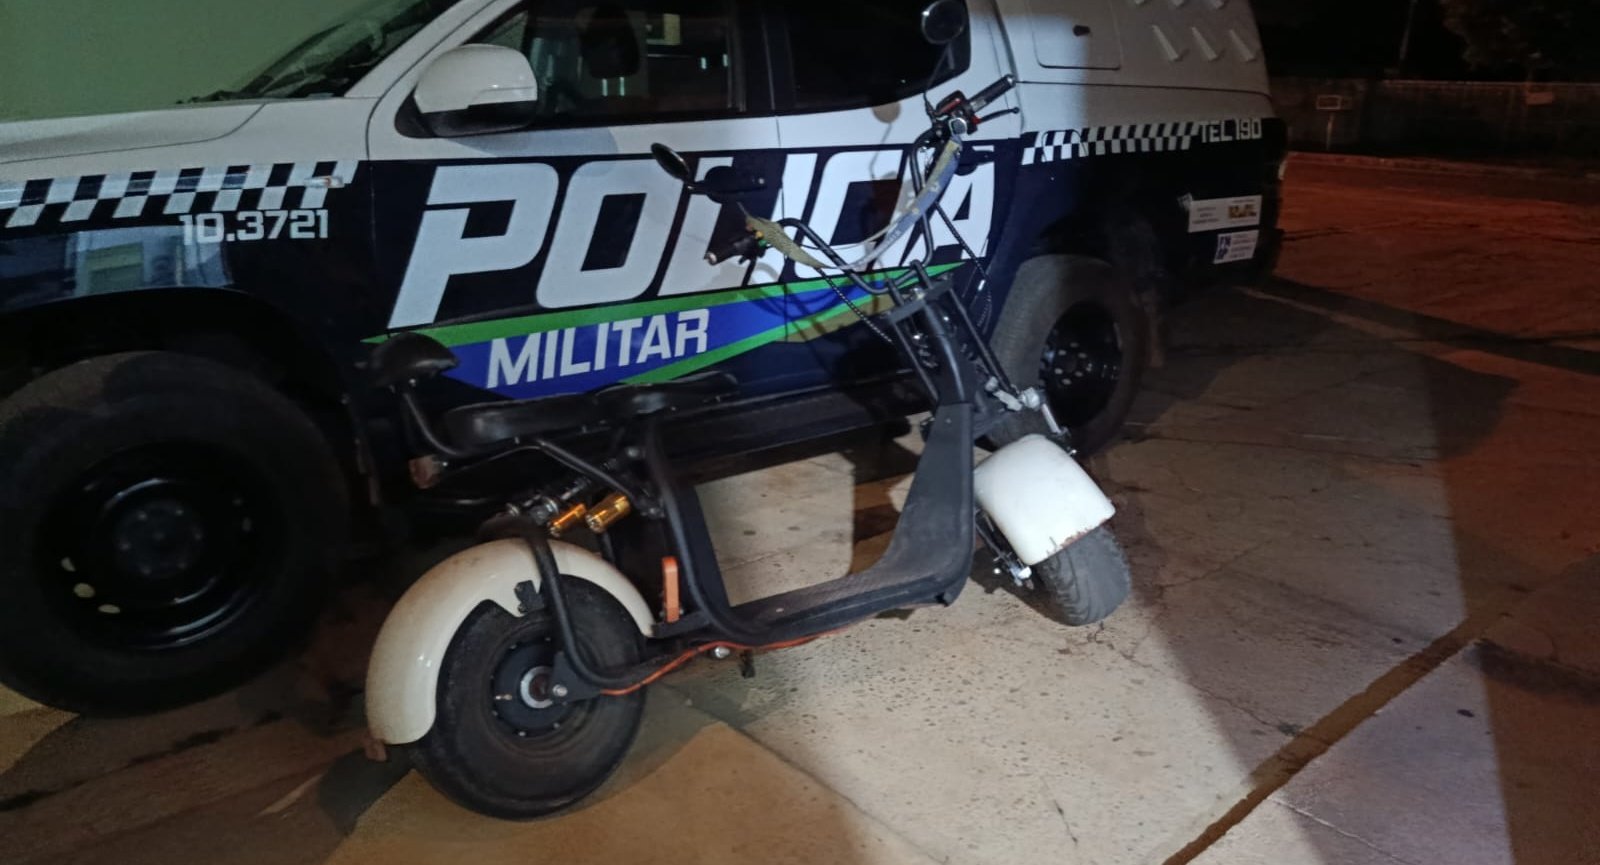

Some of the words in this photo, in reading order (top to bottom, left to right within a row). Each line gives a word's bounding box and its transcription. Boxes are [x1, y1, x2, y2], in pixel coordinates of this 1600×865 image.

[1200, 120, 1233, 143] TEL
[1233, 118, 1263, 140] 190
[179, 209, 329, 246] 10.3721
[486, 308, 710, 389] MILITAR
